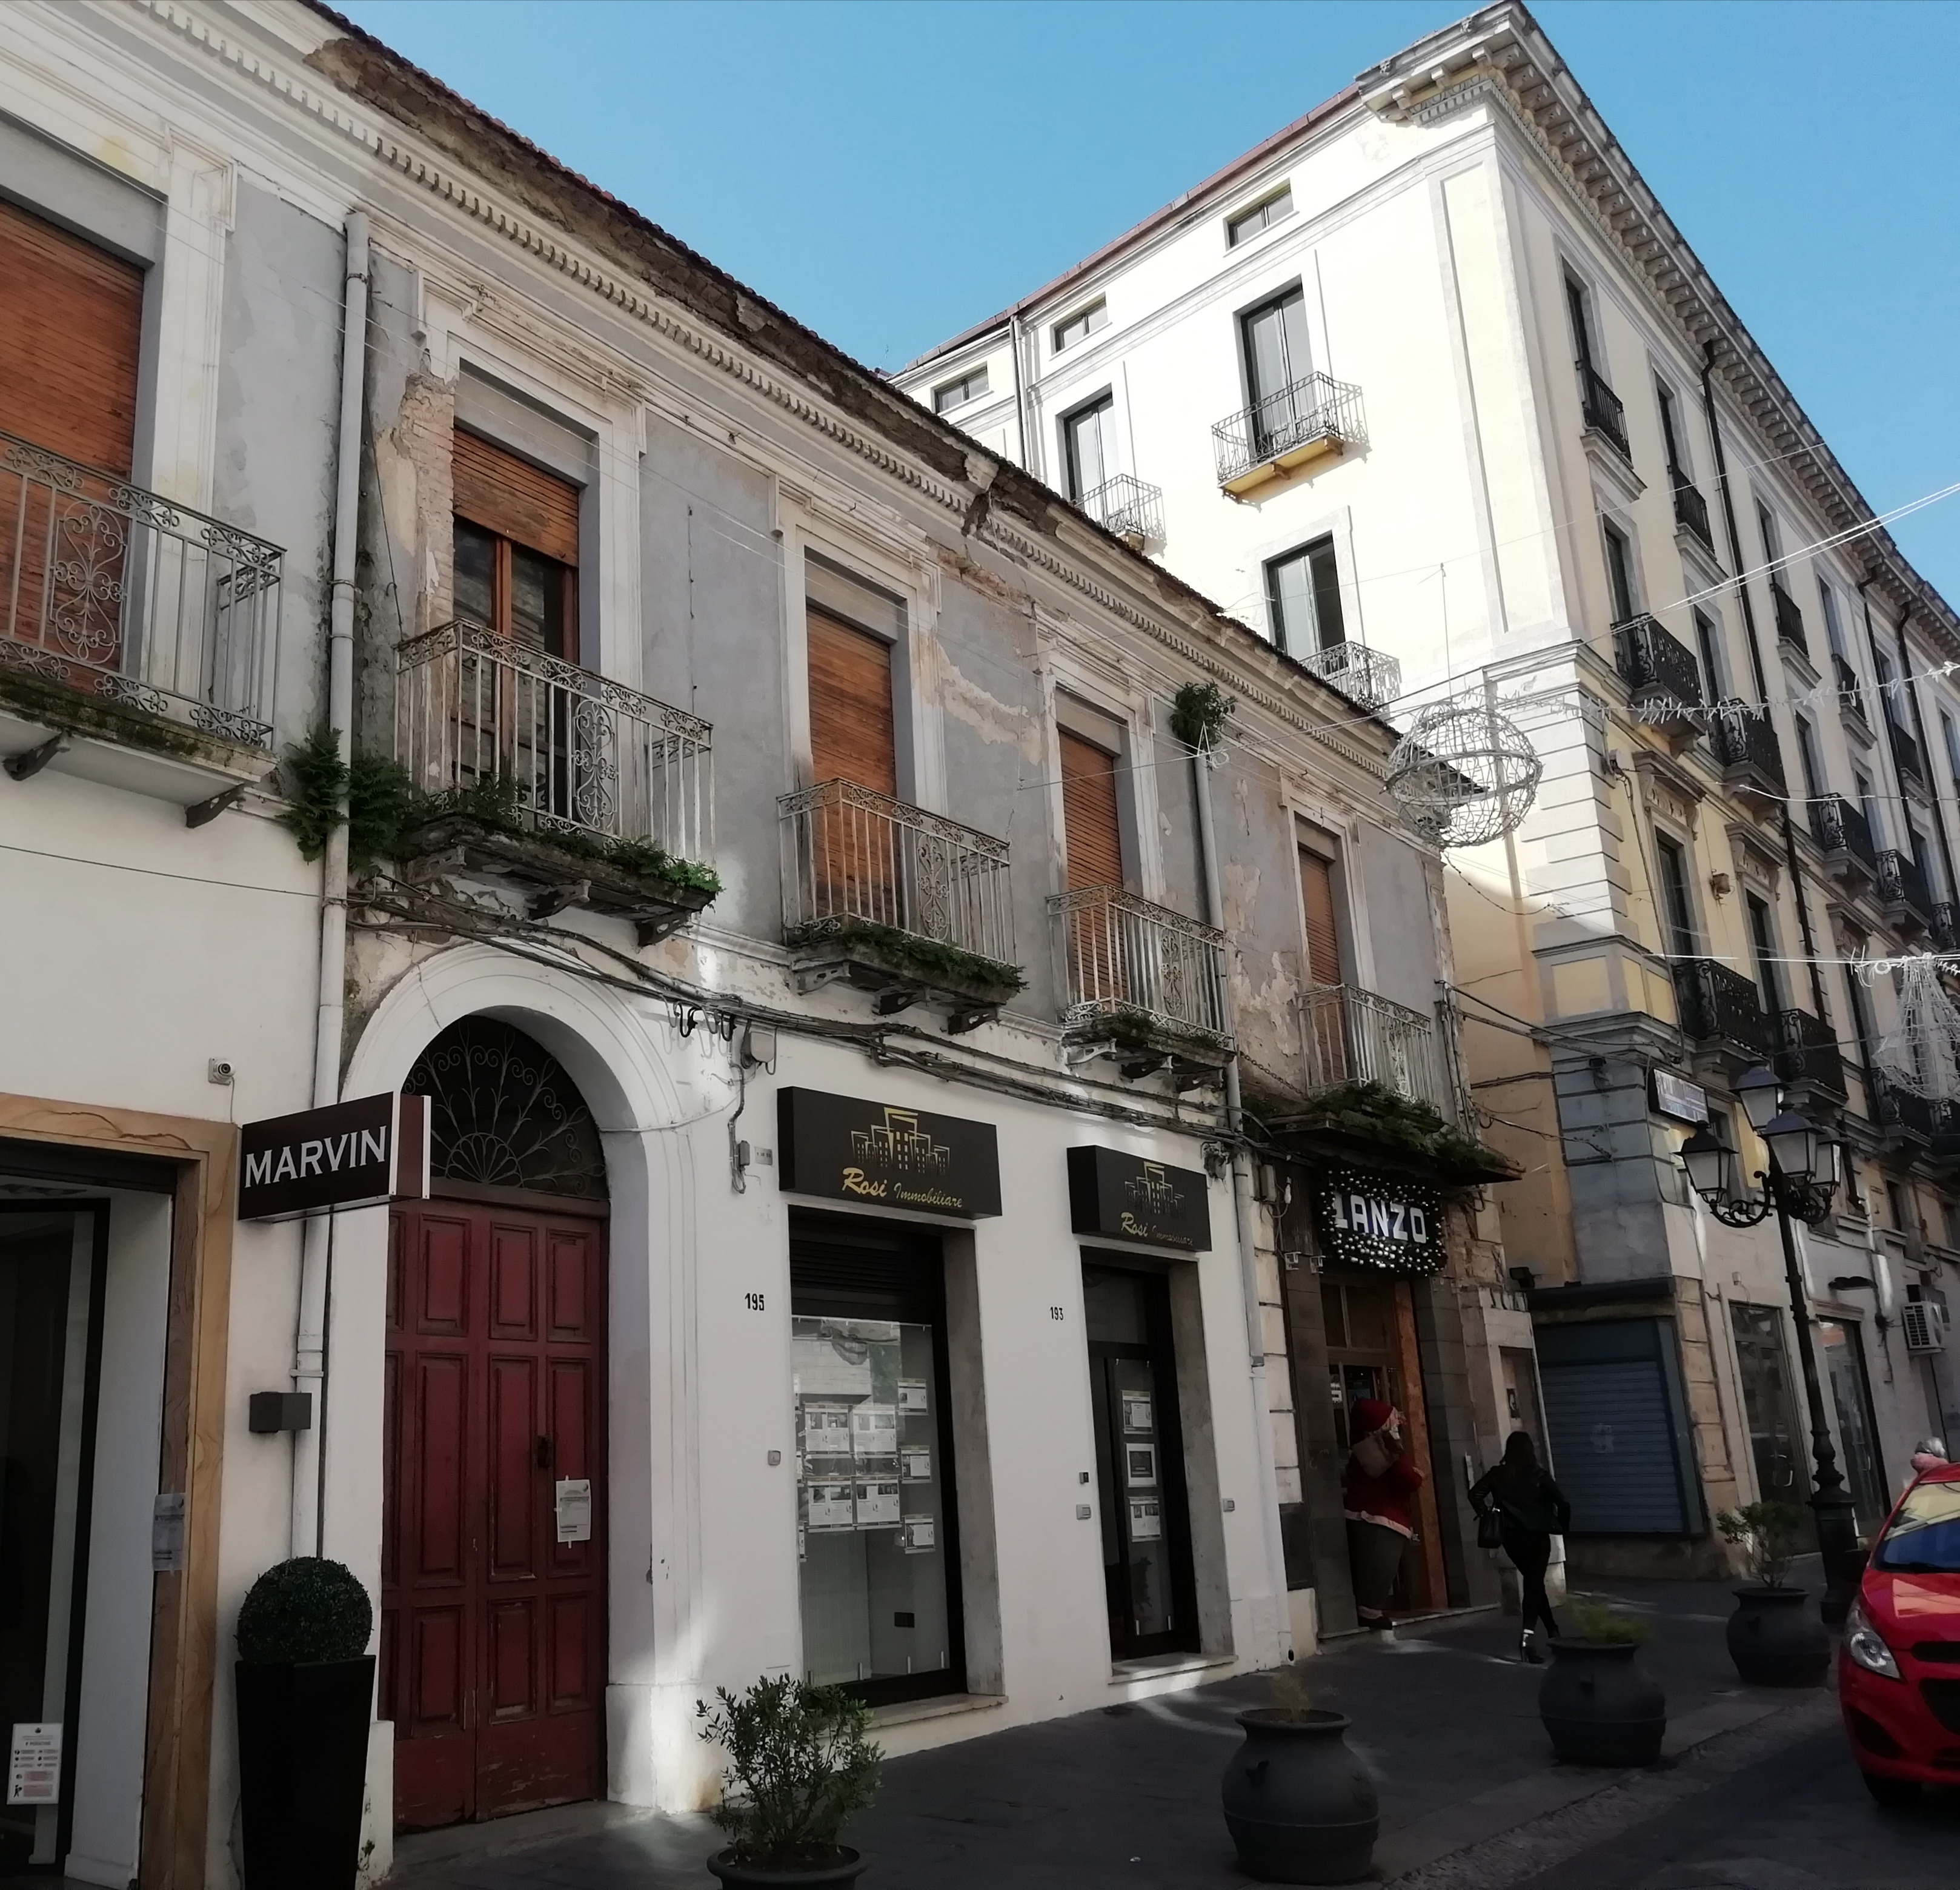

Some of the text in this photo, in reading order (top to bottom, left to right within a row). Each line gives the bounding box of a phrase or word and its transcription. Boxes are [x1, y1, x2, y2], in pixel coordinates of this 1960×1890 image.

[244, 1125, 387, 1189] MARVIN
[842, 1167, 963, 1208] Rosi Immobiliare
[1121, 1212, 1149, 1238] Rosi
[1333, 1190, 1427, 1244] LANZO
[744, 1292, 765, 1311] 195
[1049, 1306, 1064, 1321] 193
